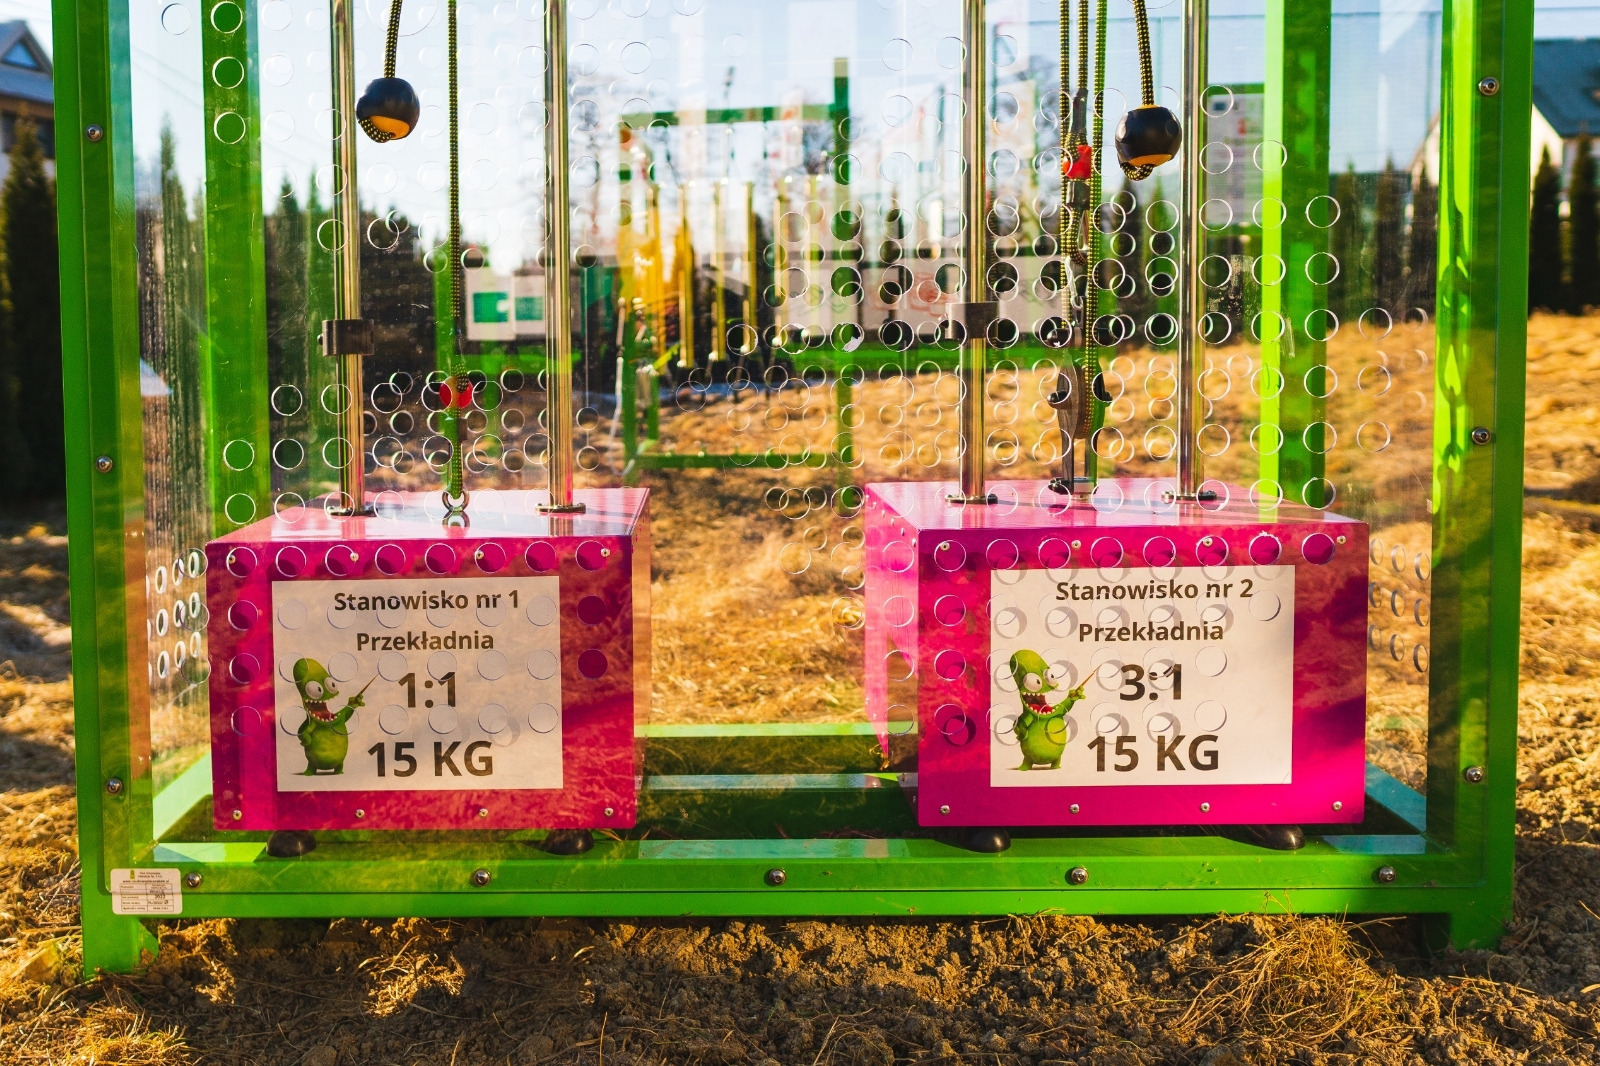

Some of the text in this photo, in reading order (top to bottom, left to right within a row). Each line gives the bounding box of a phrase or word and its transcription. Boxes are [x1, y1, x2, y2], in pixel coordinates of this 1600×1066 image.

[334, 590, 519, 611] Stanowisko nr 1
[1056, 579, 1254, 601] Stanowisko nr 2
[356, 631, 494, 651] Przekładnia
[1079, 621, 1224, 642] Przekładnia
[398, 672, 456, 709] 1:1
[1119, 664, 1182, 701] 3:1
[367, 740, 494, 777] 15 KG
[1087, 734, 1219, 772] 15 KG
